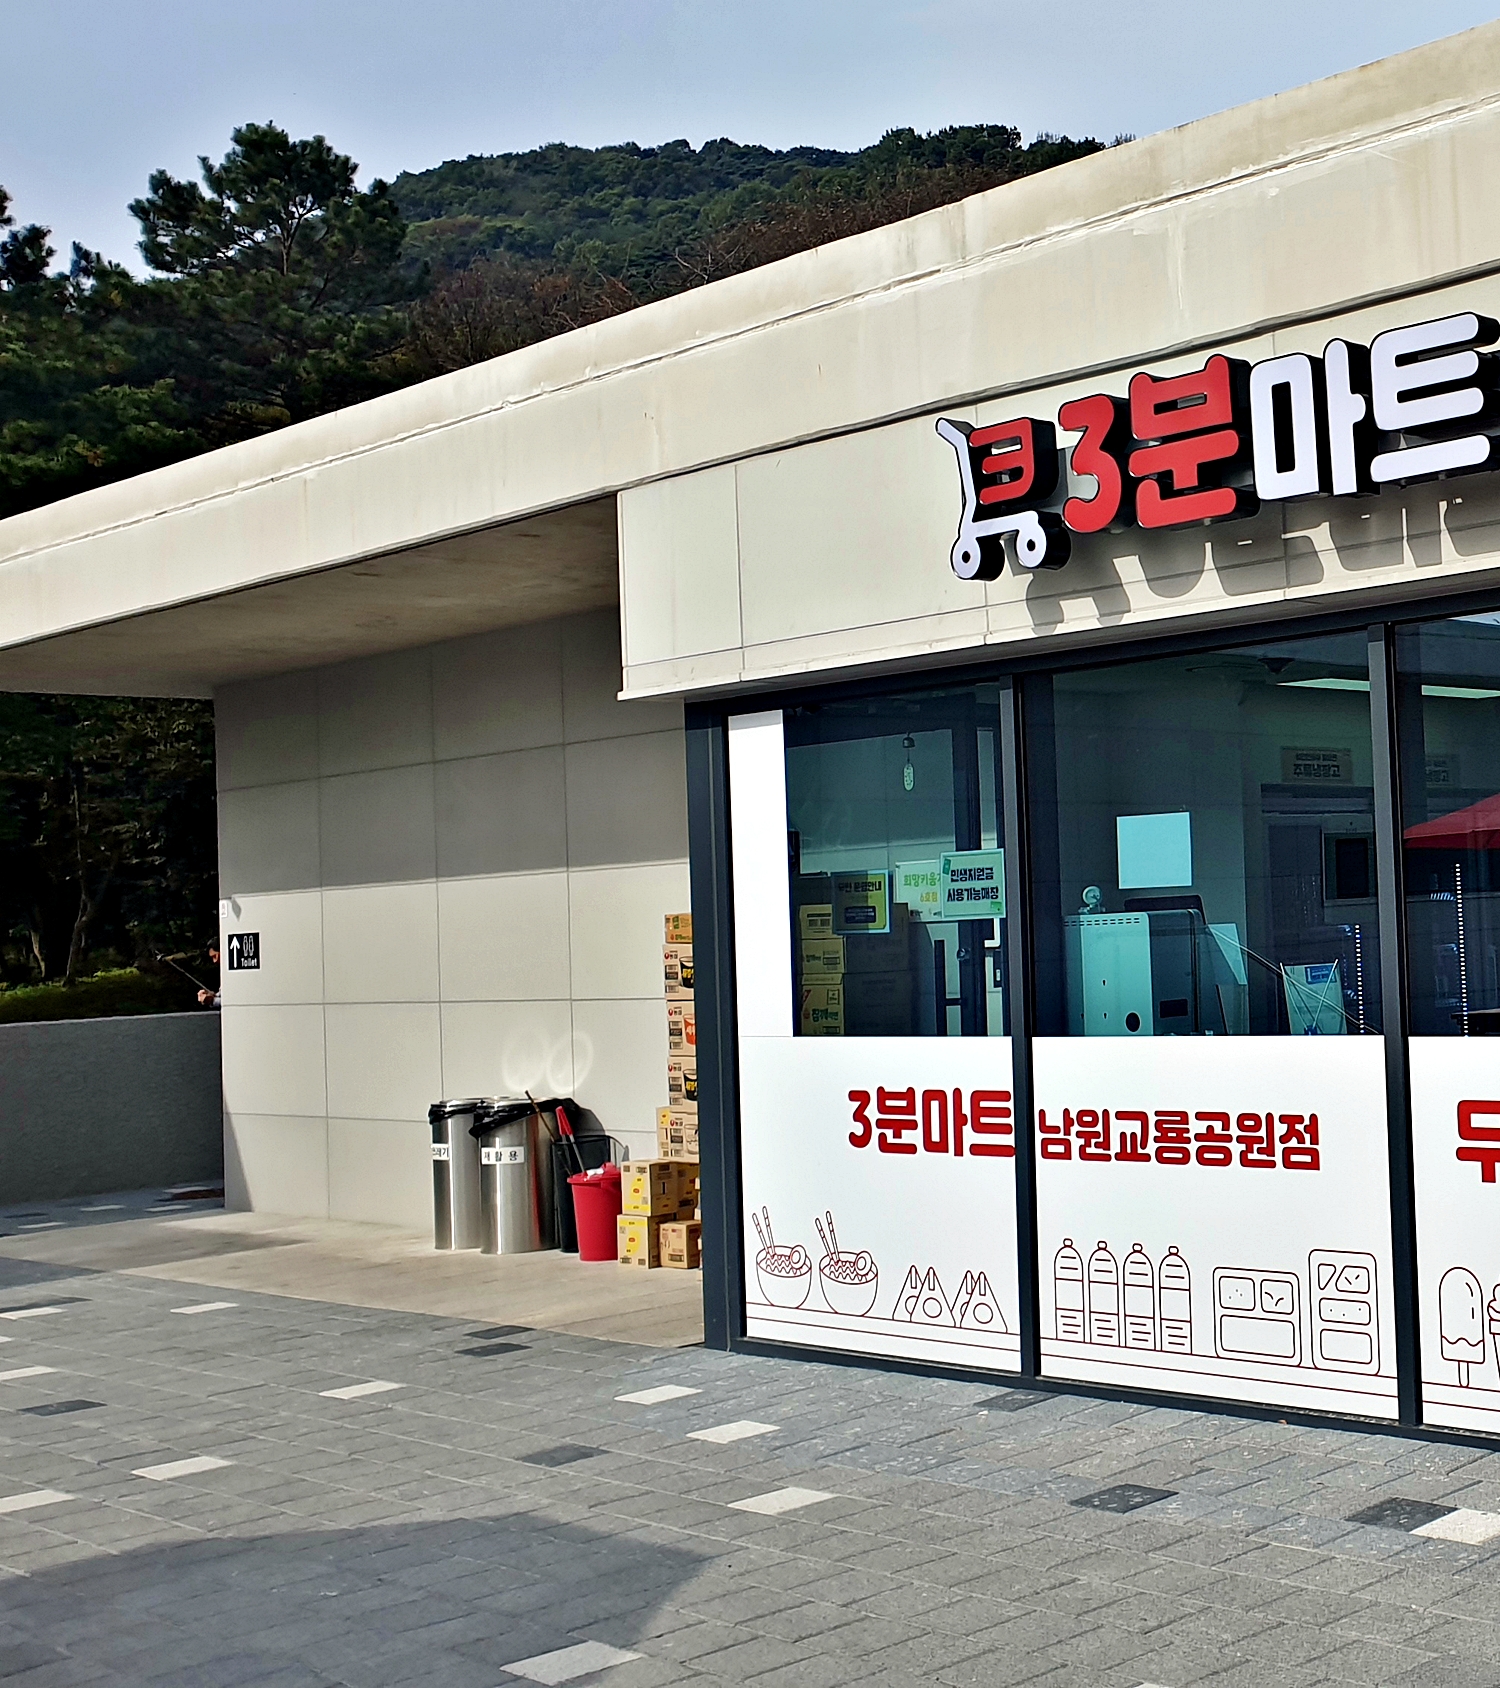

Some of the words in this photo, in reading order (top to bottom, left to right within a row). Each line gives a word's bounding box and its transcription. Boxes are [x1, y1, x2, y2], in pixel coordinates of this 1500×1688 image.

[1057, 312, 1492, 534] 3분마트
[950, 867, 994, 883] 민생지원금
[241, 957, 257, 967] Toilet
[847, 1086, 1016, 1157] 3분마트
[1038, 1107, 1322, 1171] 남원교룡공원점
